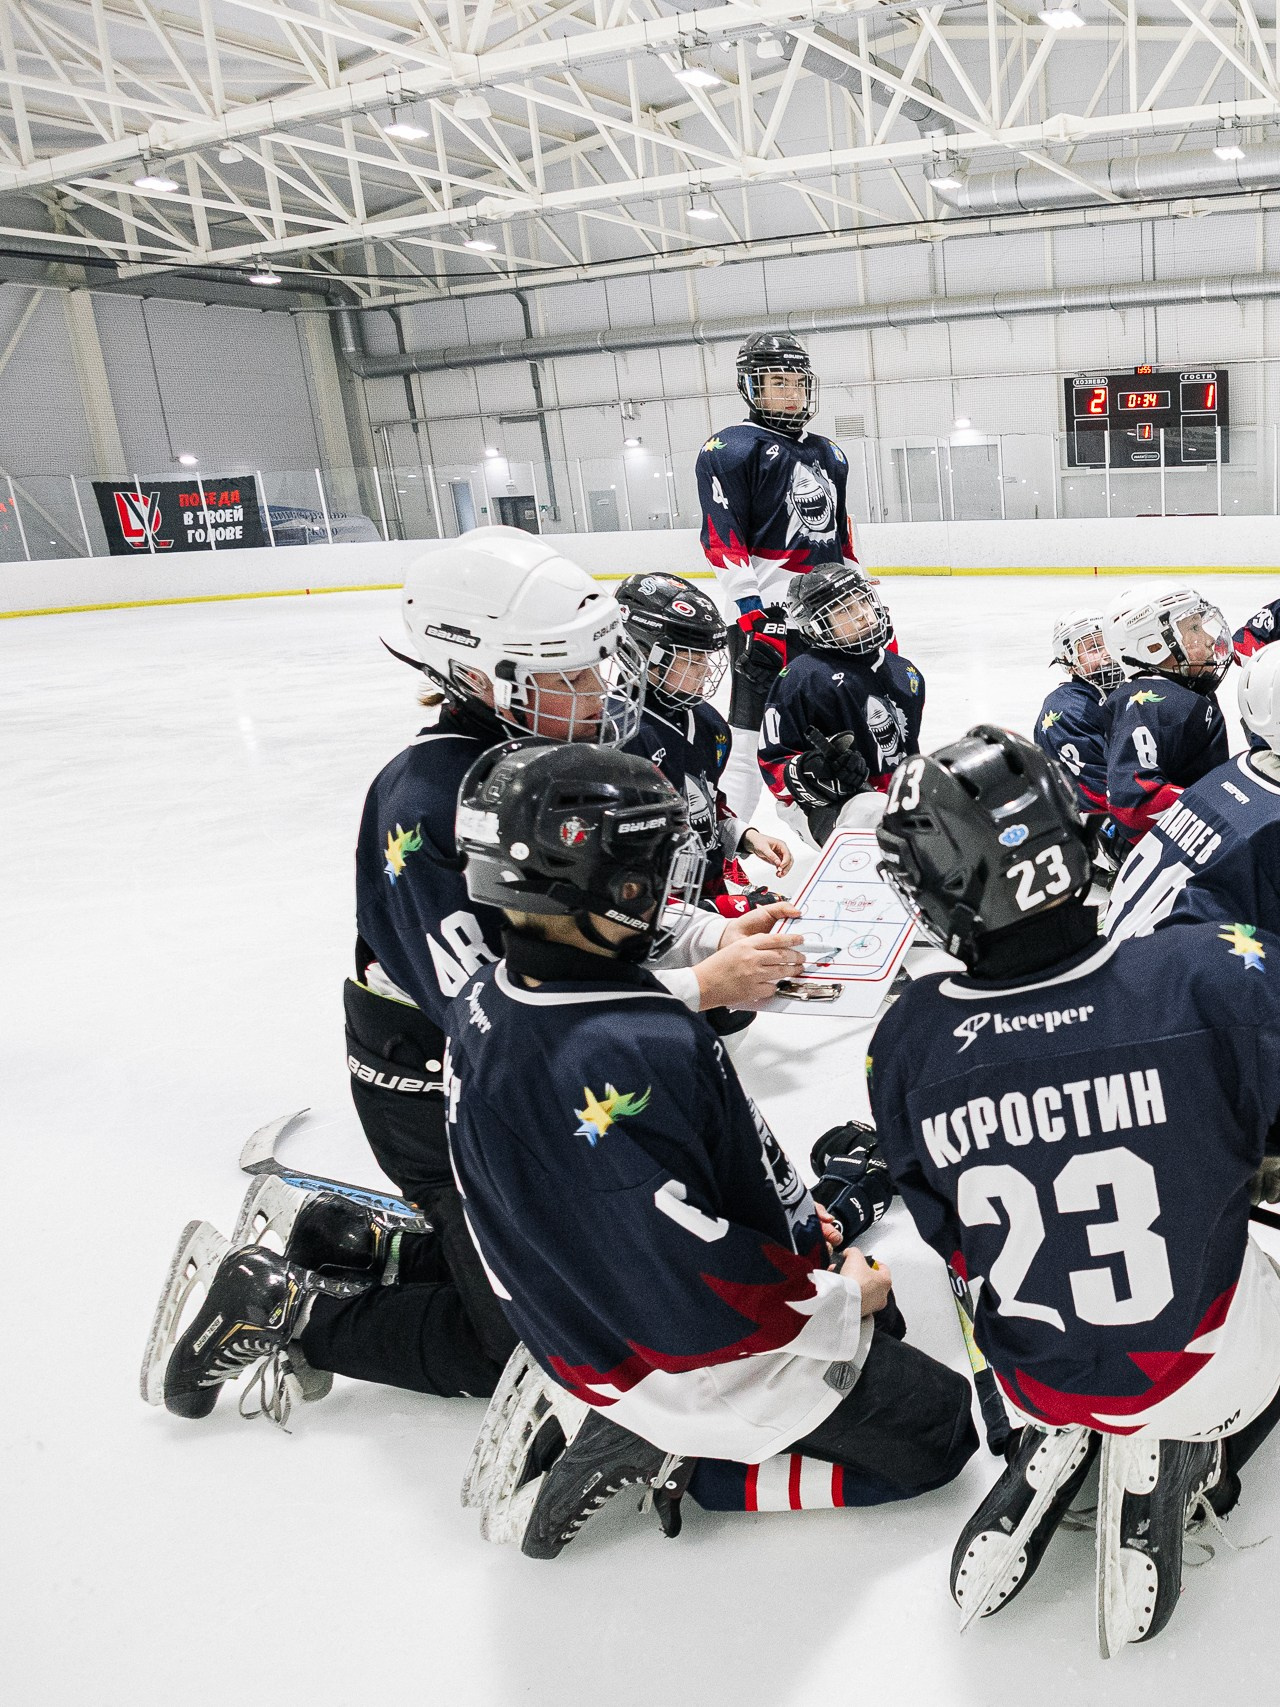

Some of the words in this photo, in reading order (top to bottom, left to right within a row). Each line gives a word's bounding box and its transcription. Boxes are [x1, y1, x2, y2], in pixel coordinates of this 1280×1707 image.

[1090, 389, 1106, 413] 2
[1128, 393, 1157, 408] 0:34
[1206, 384, 1215, 408] 1
[1144, 425, 1150, 439] 1
[713, 475, 729, 510] 4
[183, 511, 193, 525] В
[197, 505, 244, 524] ТВОЕЙ
[187, 528, 243, 543] ГОЛОВЕ
[631, 615, 663, 629] BAUER
[426, 627, 478, 649] BAUER
[1132, 726, 1158, 769] 8
[617, 817, 667, 834] BAUER
[1006, 844, 1072, 912] 23
[605, 907, 650, 931] BAUER
[426, 910, 501, 998] 48
[993, 1003, 1095, 1037] keeper
[348, 1054, 445, 1092] BAUER
[957, 1146, 1175, 1333] 23
